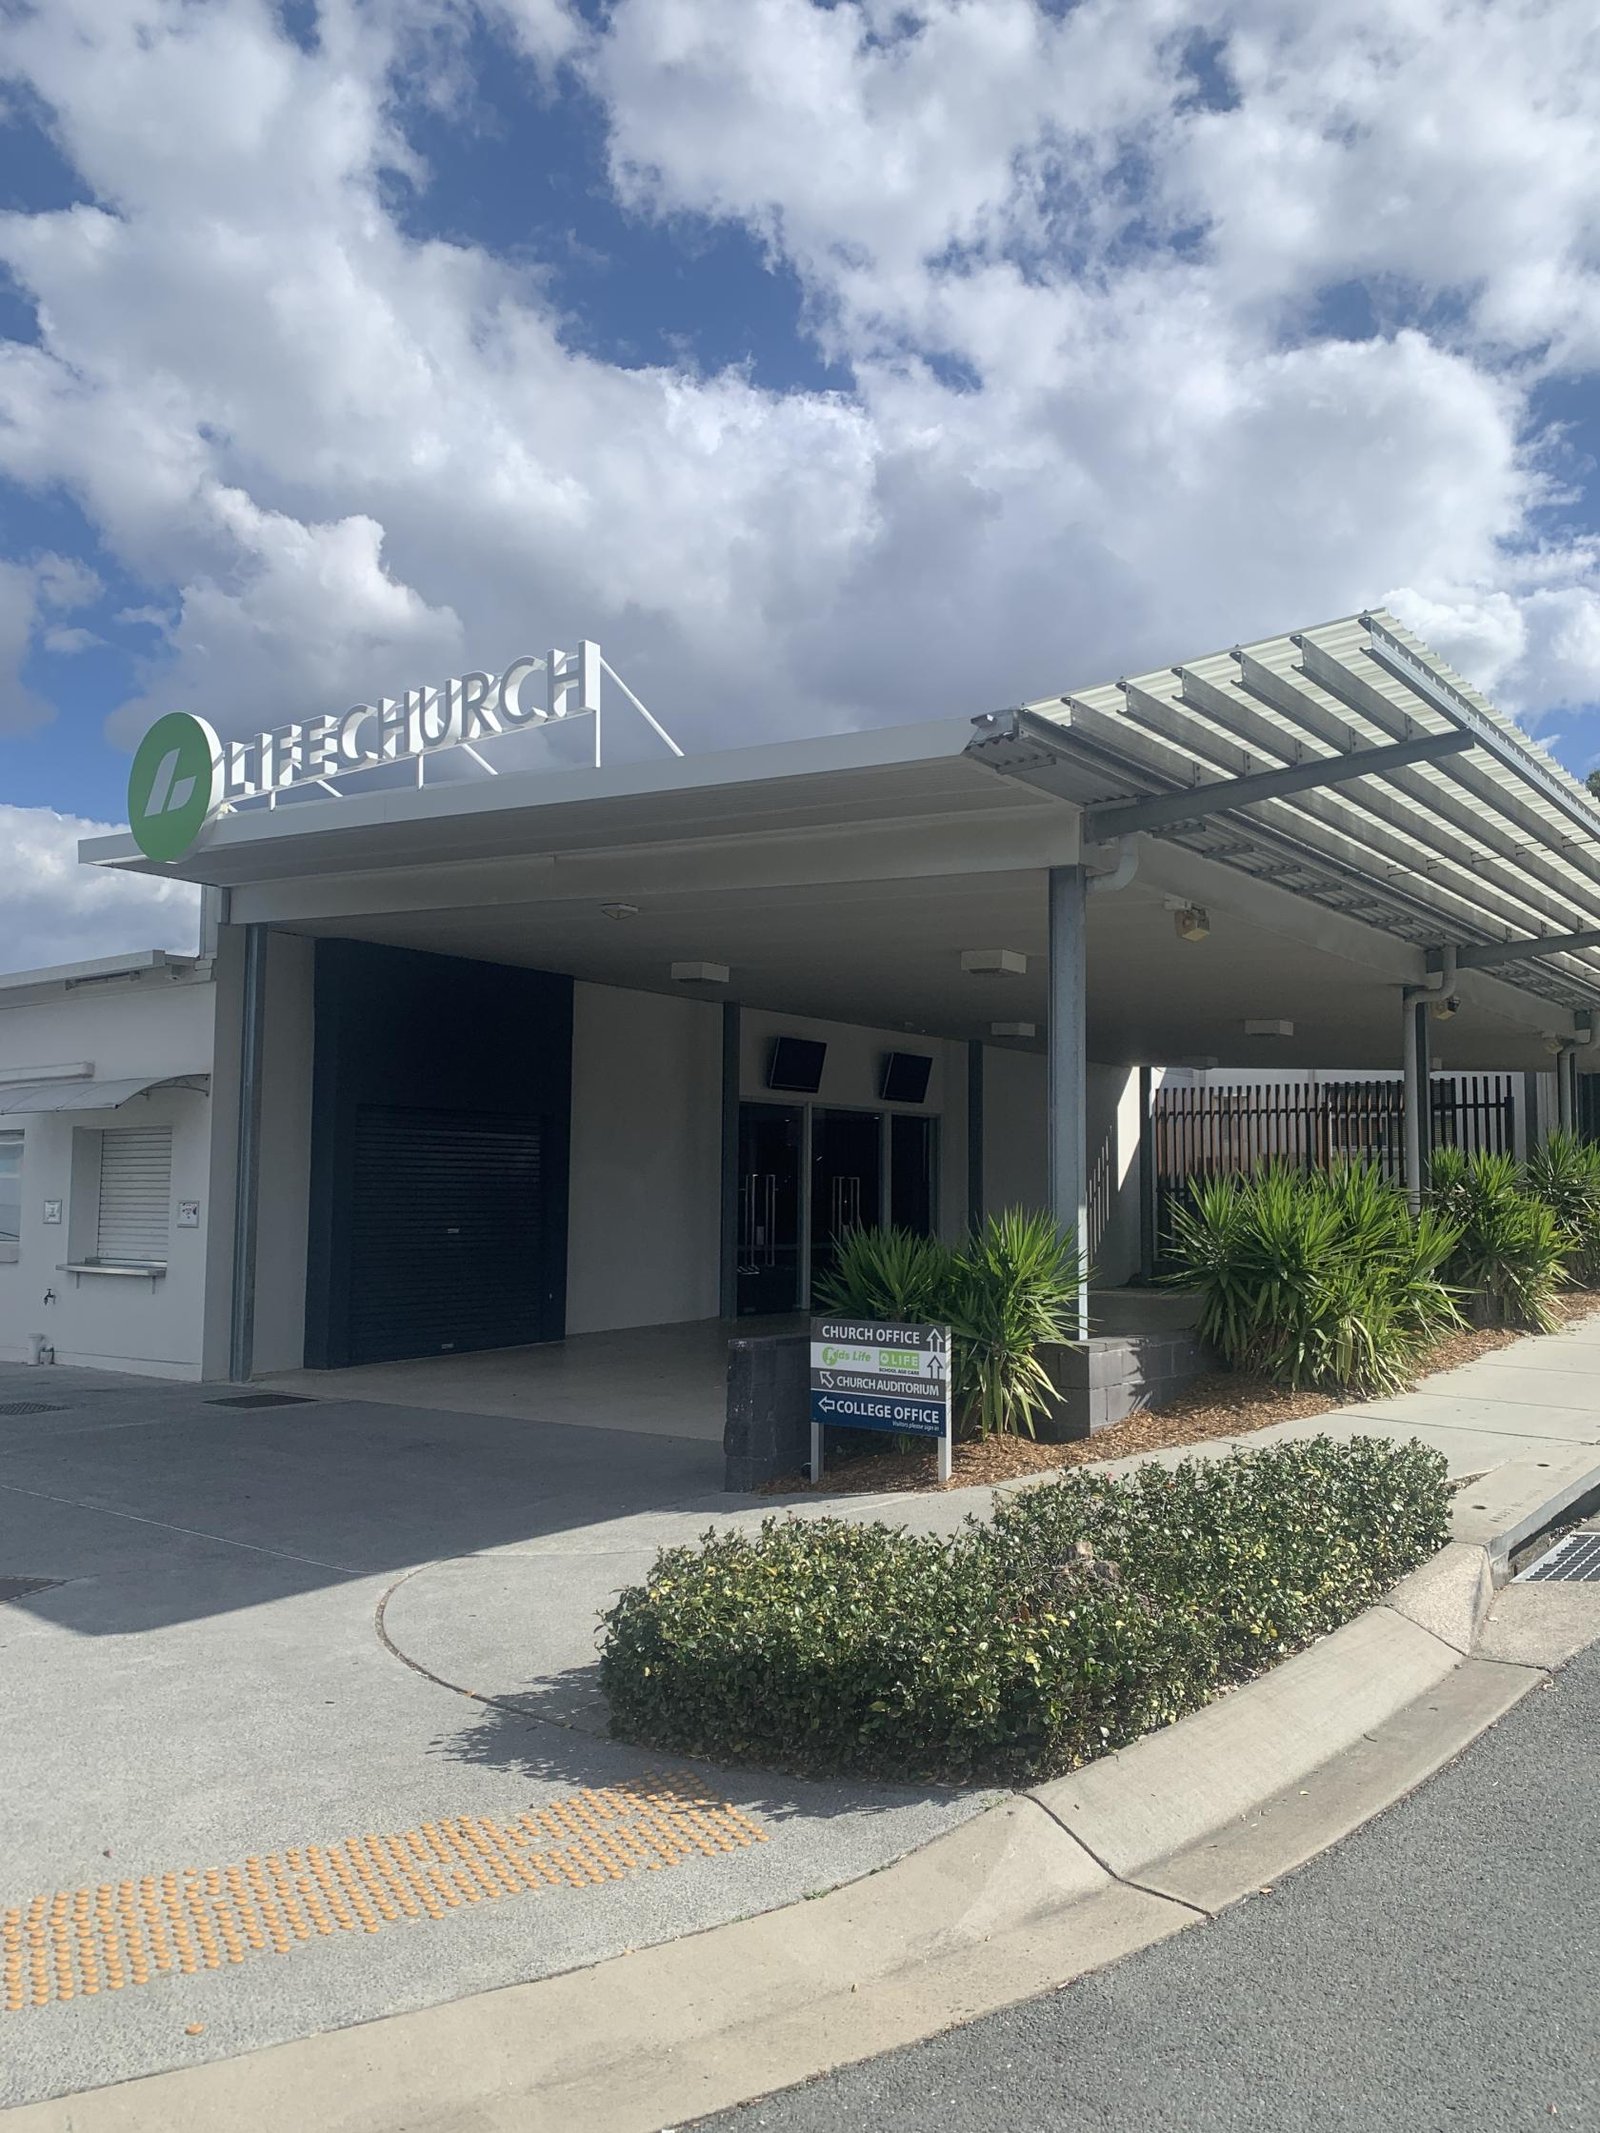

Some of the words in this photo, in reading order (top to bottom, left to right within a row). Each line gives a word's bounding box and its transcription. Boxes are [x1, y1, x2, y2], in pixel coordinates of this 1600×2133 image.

[224, 640, 600, 797] LIFECHURCH
[822, 1325, 873, 1341] CHURCH
[876, 1329, 920, 1344] OFFICE
[852, 1350, 871, 1362] Life
[891, 1353, 918, 1367] LIFE
[837, 1375, 876, 1390] CHURCH
[877, 1381, 939, 1396] AUDITORIUM
[837, 1400, 891, 1418] COLLEGE
[894, 1407, 939, 1424] OFFICE
